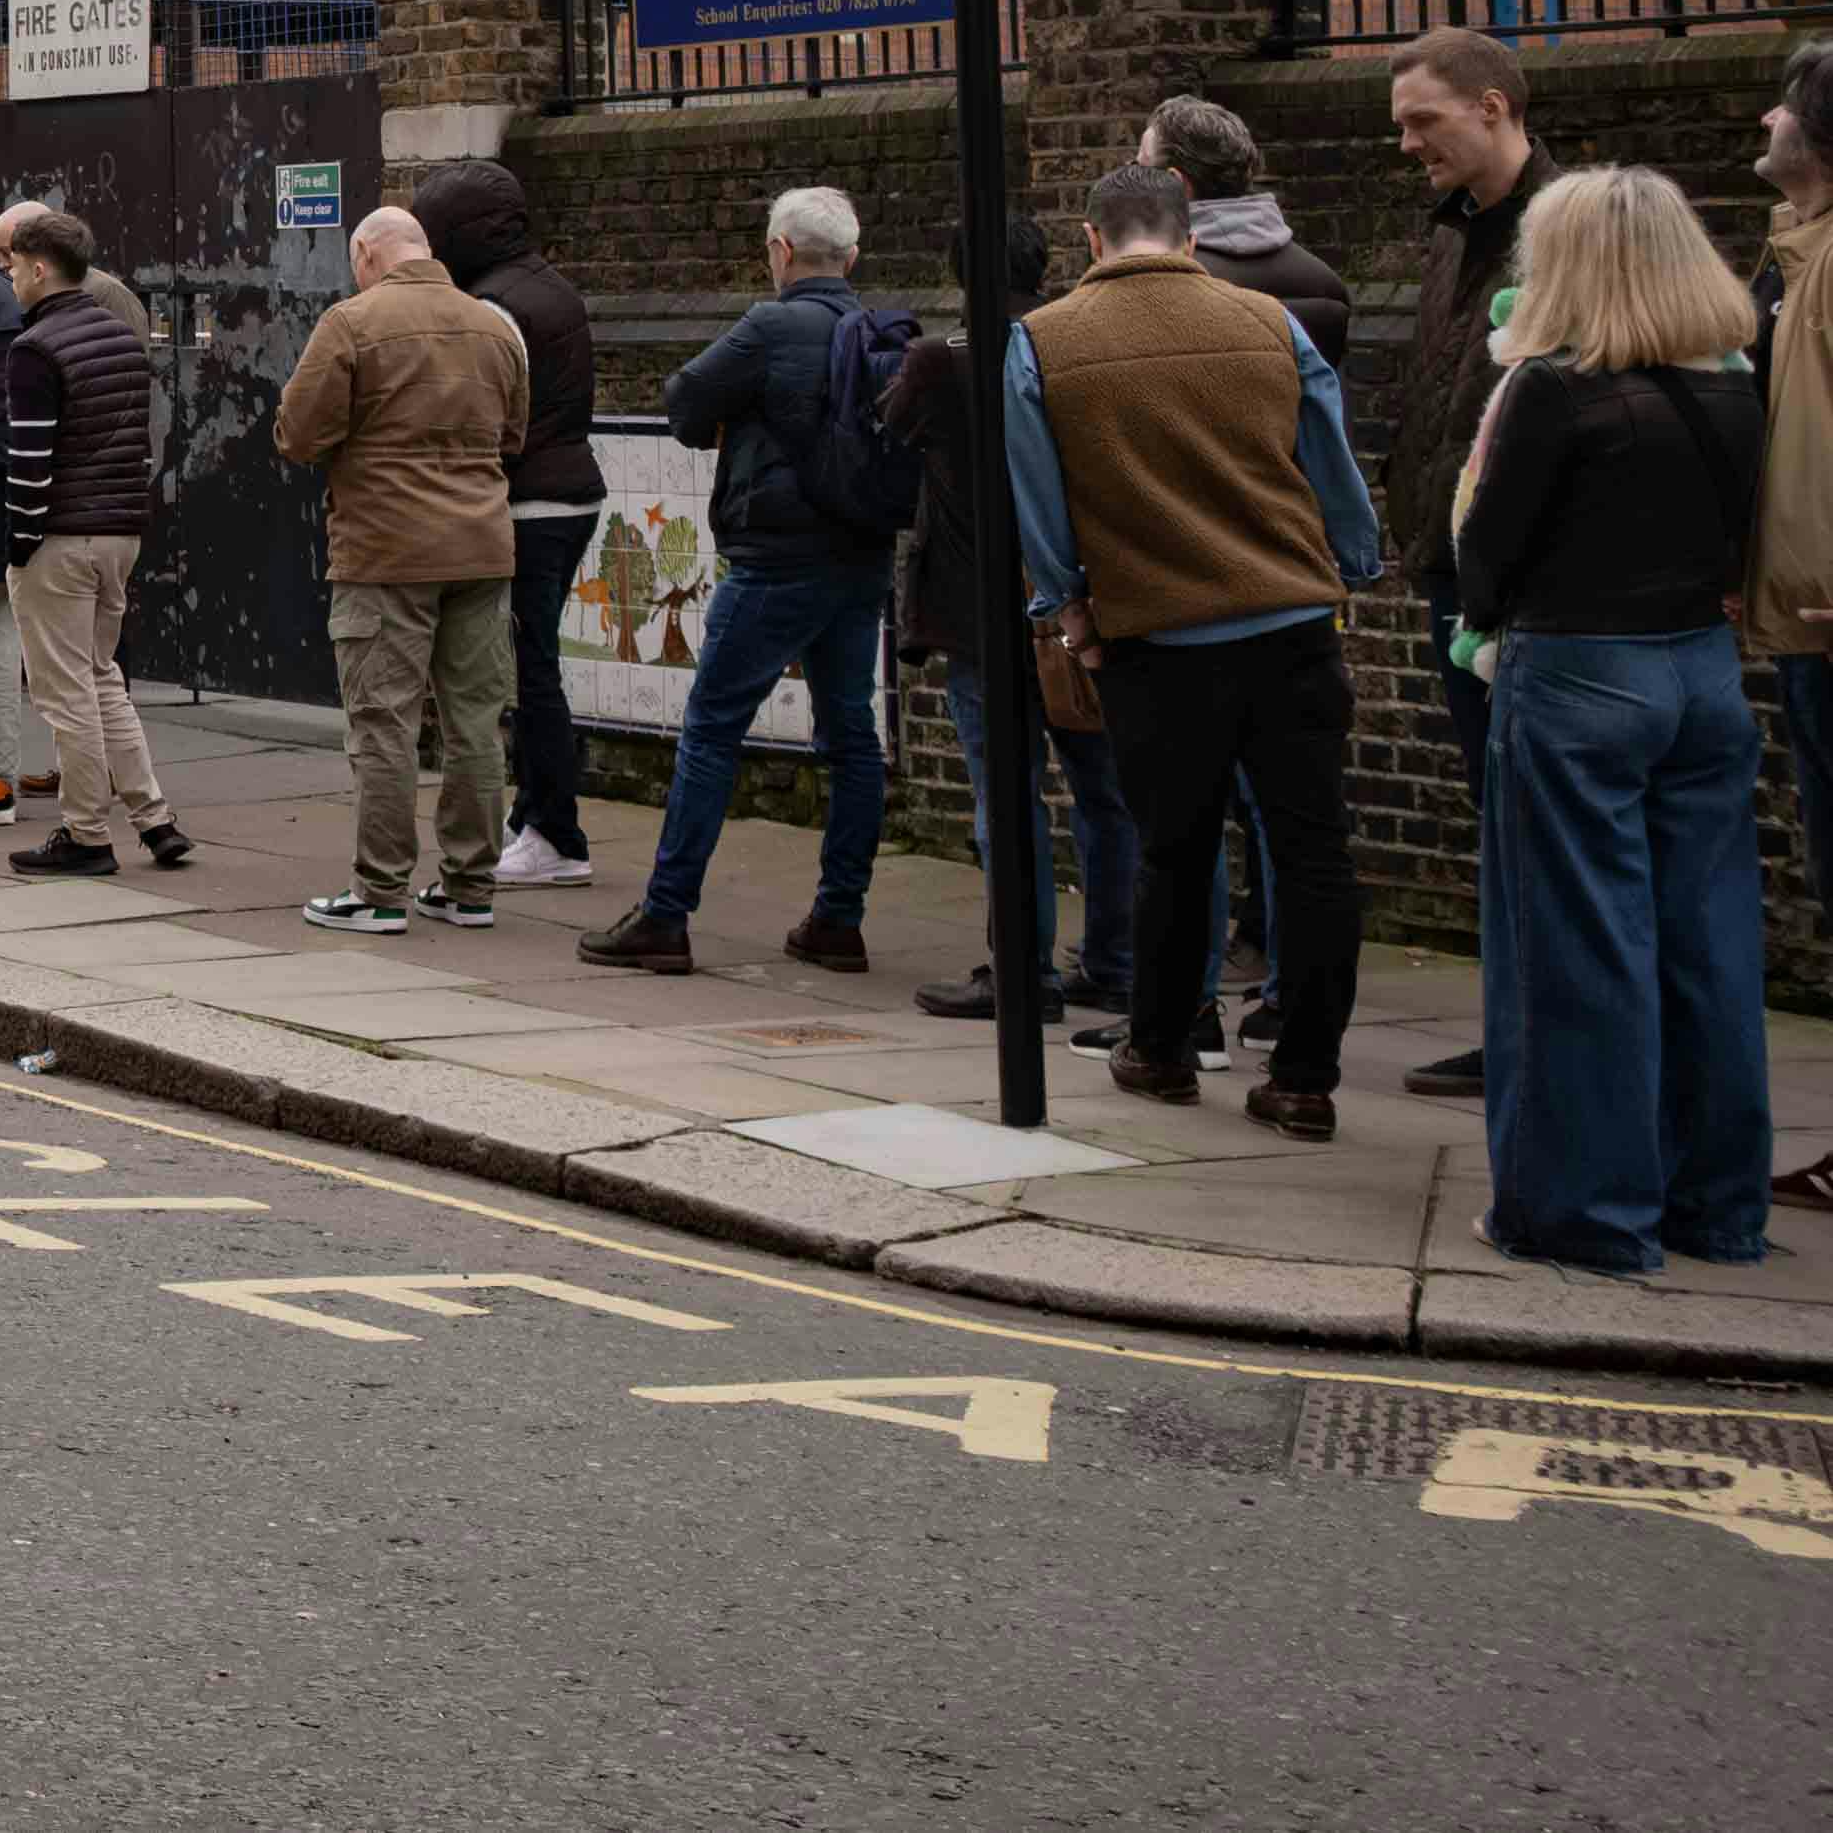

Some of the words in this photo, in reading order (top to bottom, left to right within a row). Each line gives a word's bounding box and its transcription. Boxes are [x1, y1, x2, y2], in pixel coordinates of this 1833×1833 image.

[15, 3, 57, 38] FIRE
[694, 5, 738, 26] School
[23, 50, 35, 73] IN
[40, 46, 102, 71] CONSTANT
[108, 44, 133, 66] USE
[293, 173, 310, 189] Fire
[294, 202, 314, 218] Keep
[314, 202, 333, 215] clear
